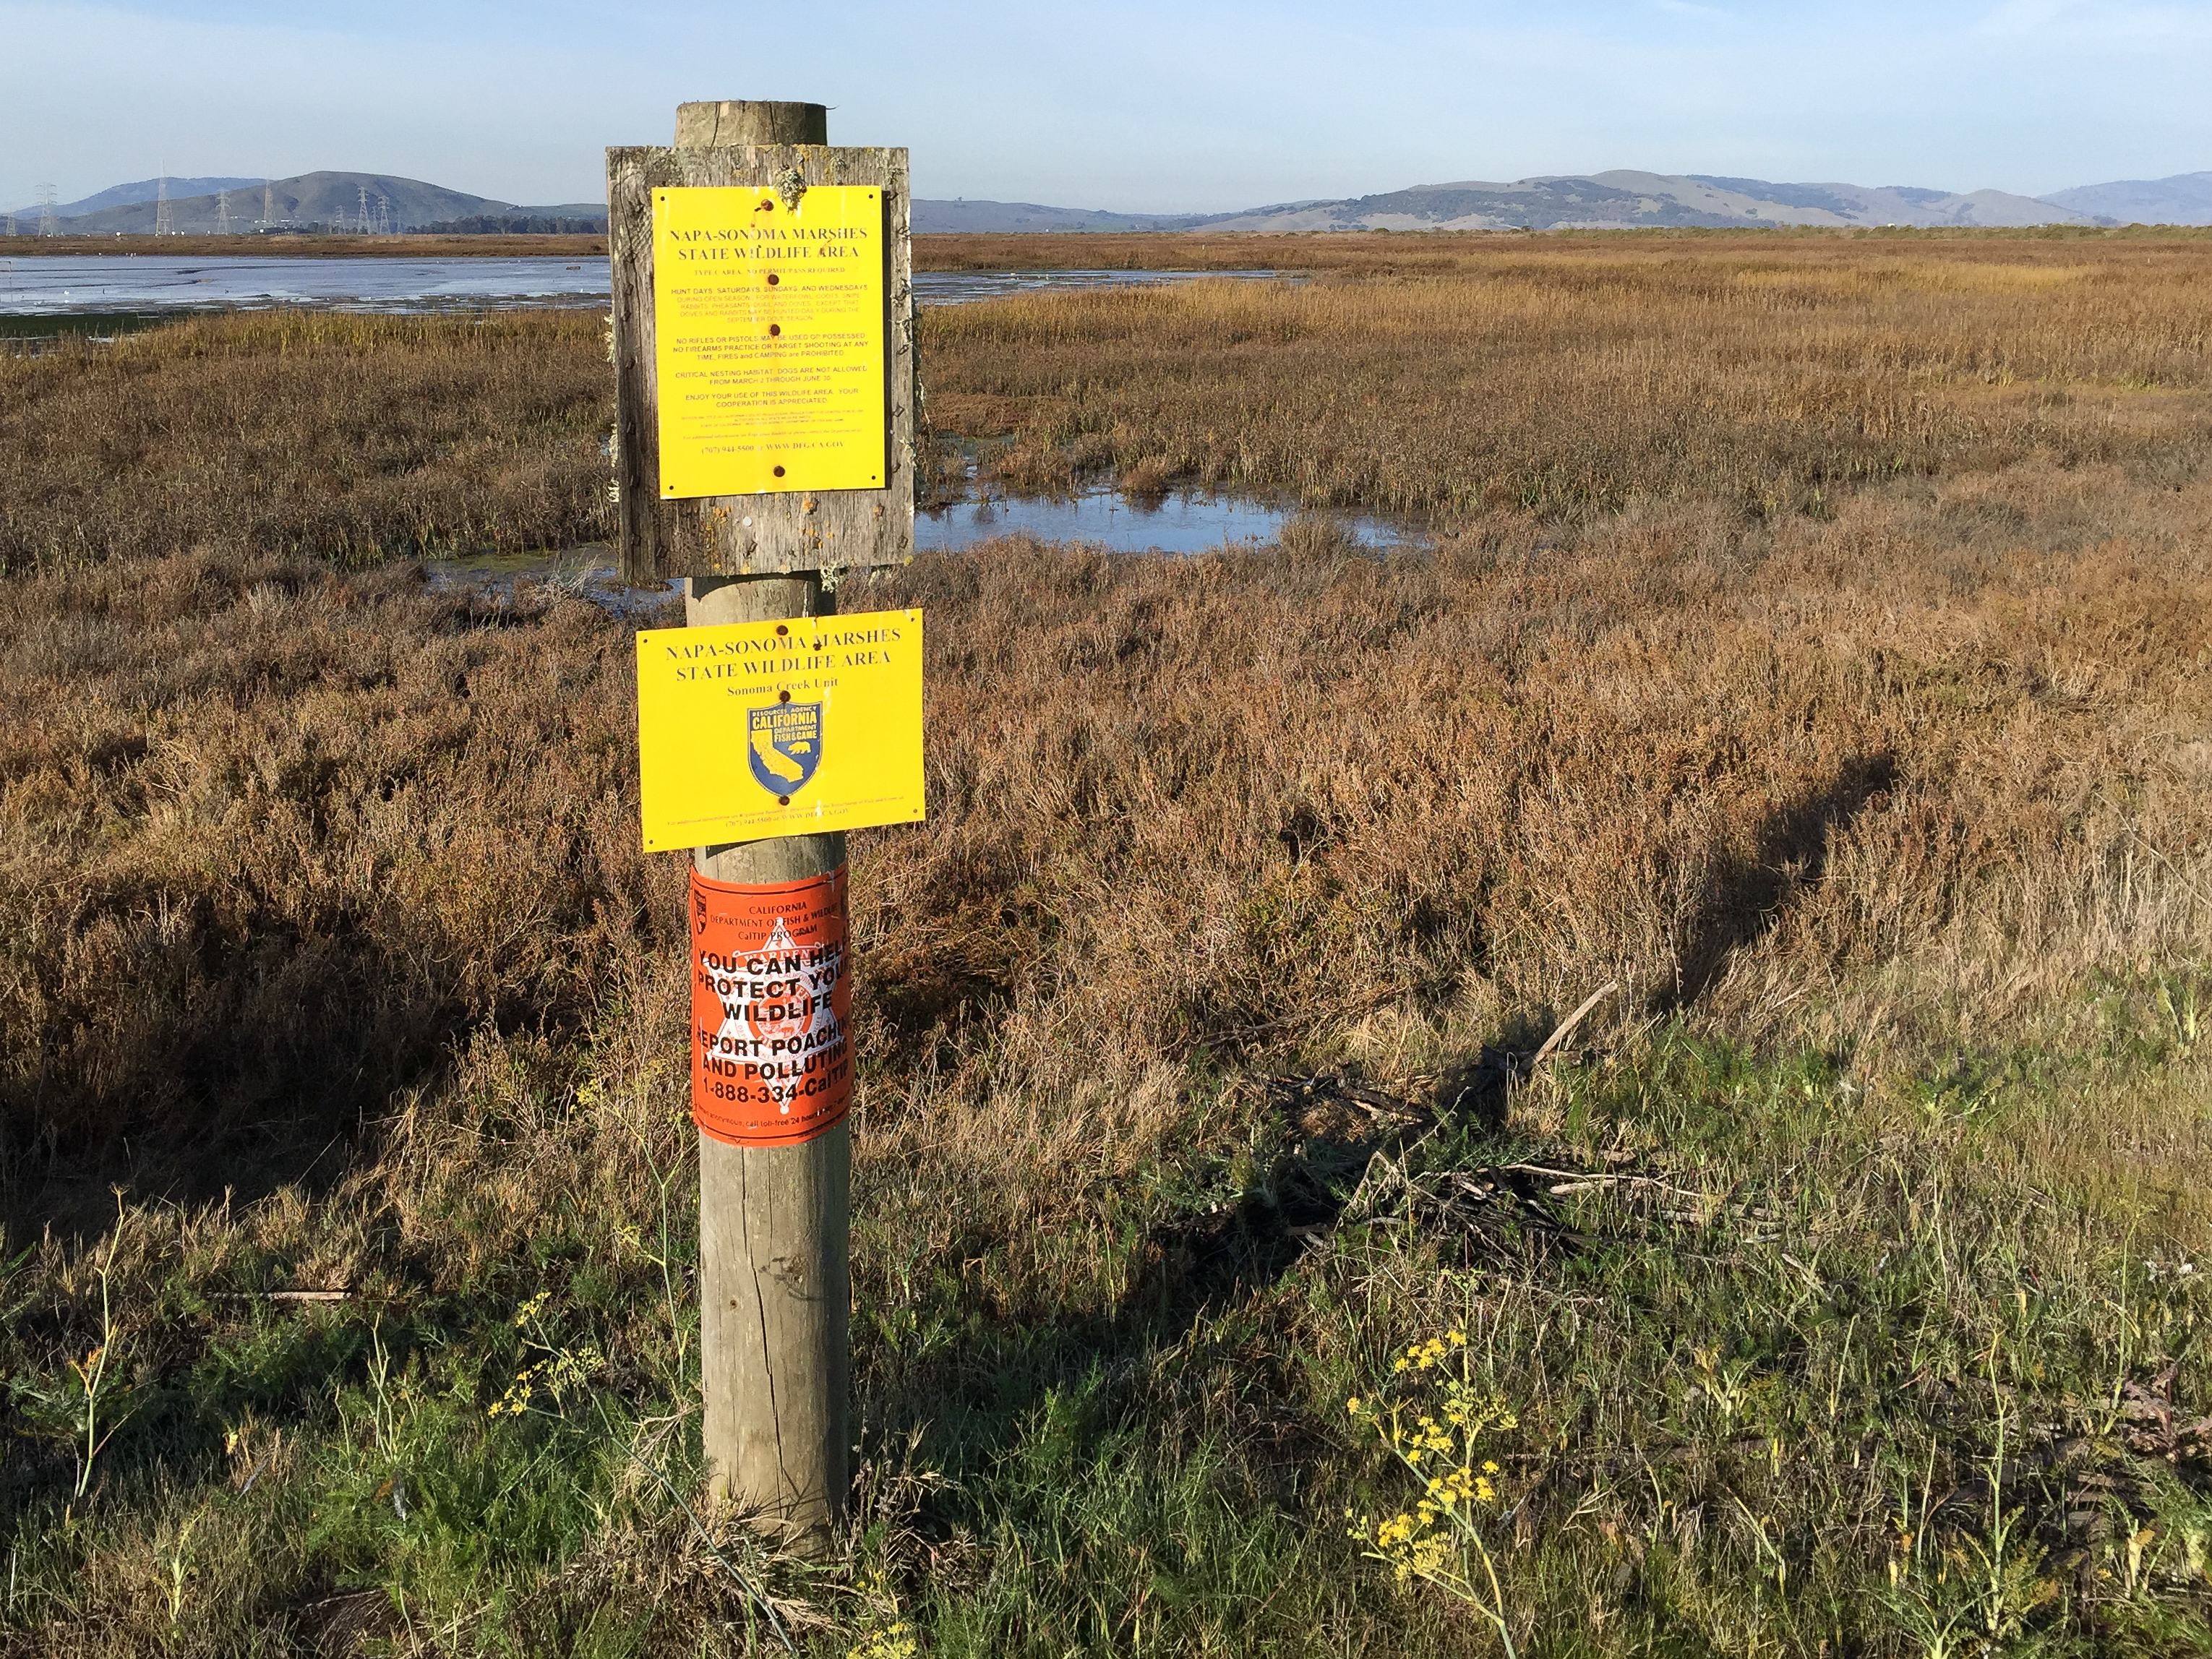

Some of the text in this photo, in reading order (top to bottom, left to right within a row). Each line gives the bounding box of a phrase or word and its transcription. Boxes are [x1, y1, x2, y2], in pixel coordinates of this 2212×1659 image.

[670, 228, 867, 241] NAPA-SONOMA MARSHES
[678, 246, 859, 260] STATE WILDLIFE AREA
[716, 400, 768, 408] COOPERATION
[666, 627, 901, 661] NAPA-SONOMA MARSHES
[676, 651, 891, 682] STATE WILDLIFE AREA
[727, 677, 839, 697] Sonoma Creek Unit
[753, 711, 817, 730] CALIFORNIA
[773, 724, 817, 734] DEPARTMENT
[748, 901, 807, 916] CALIFORNIA
[710, 914, 763, 927] DEPARTMENT
[766, 917, 781, 928] OF
[783, 914, 801, 926] FISH
[803, 913, 809, 922] &
[737, 924, 818, 940] CalTIP PROGRAM
[698, 947, 737, 974] YOU
[747, 953, 800, 976] CAN
[698, 969, 801, 999] PROTECT
[723, 990, 832, 1022] WILDLIFE
[703, 1053, 737, 1078] AND
[745, 1037, 847, 1081] POLLUTING
[703, 1058, 849, 1103] 1-888-334-CalTIP
